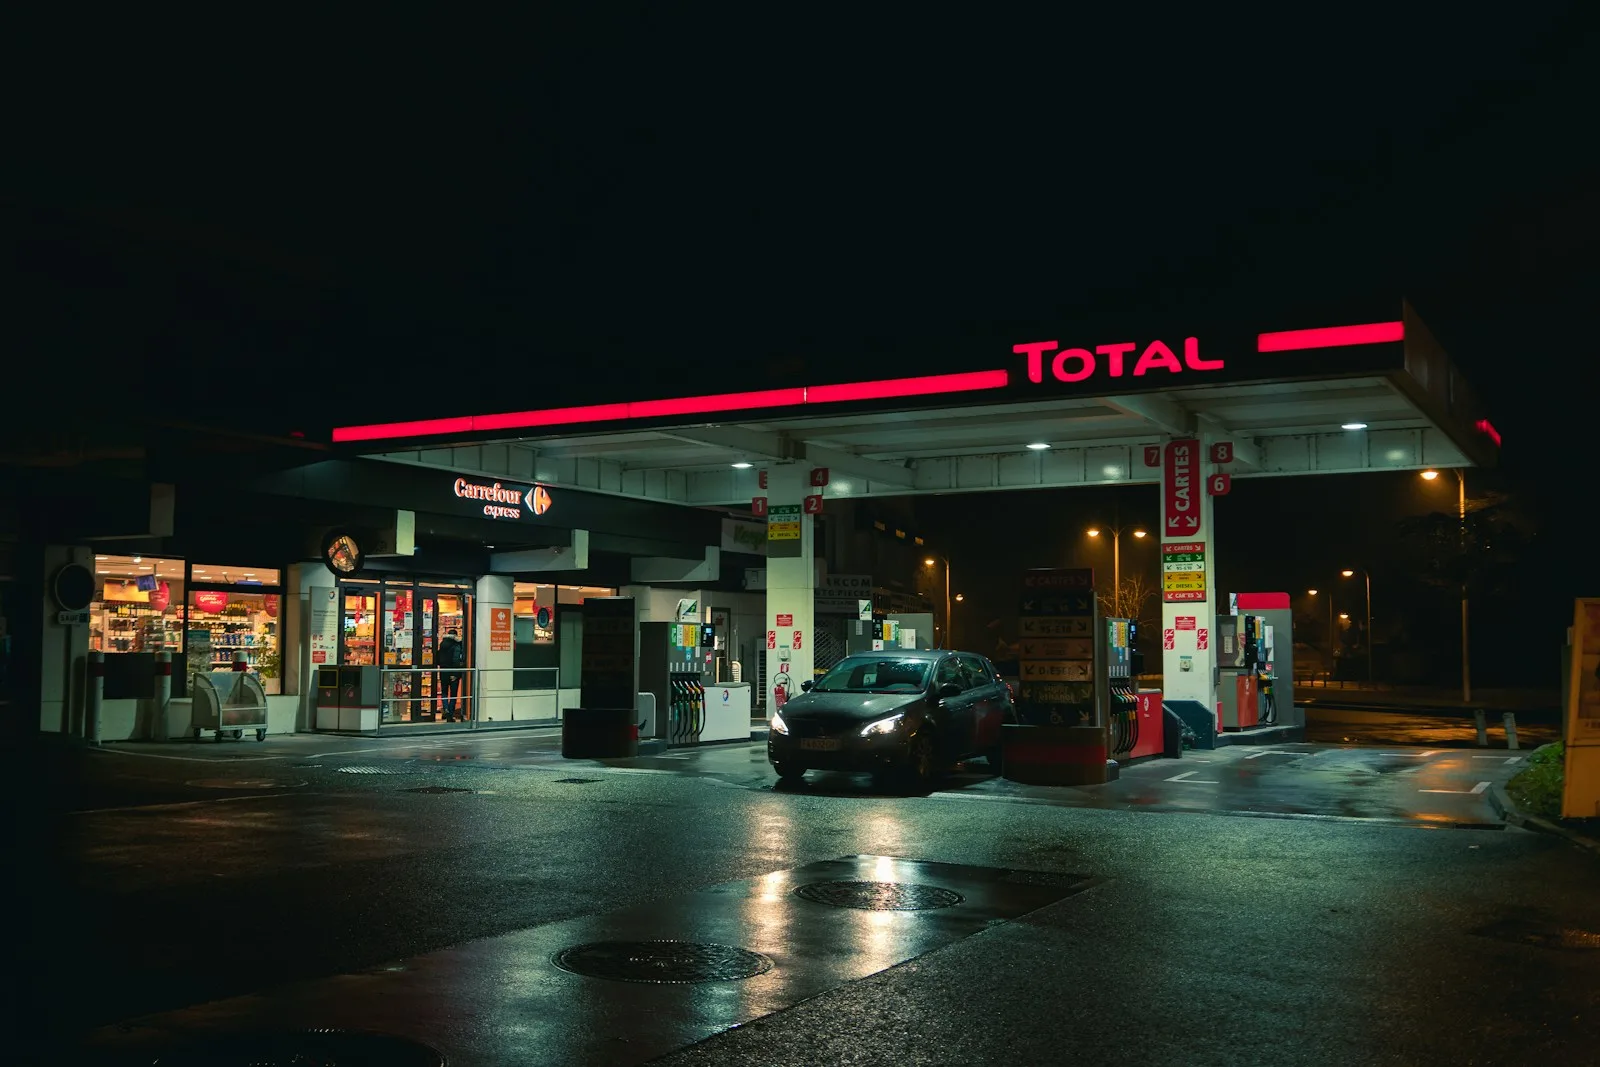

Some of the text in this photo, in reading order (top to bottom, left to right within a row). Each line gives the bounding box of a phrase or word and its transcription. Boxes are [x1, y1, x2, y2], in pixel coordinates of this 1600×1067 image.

[1013, 337, 1225, 384] TOTAL
[1149, 449, 1159, 464] 7
[1217, 445, 1228, 460] 8
[815, 471, 824, 485] 4
[1174, 445, 1191, 512] CARTES
[1213, 476, 1225, 492] 6
[454, 477, 522, 505] Carrefour
[484, 504, 520, 519] express
[756, 499, 763, 513] 1
[809, 497, 818, 511] 2
[1037, 576, 1075, 586] CARTES
[1039, 625, 1072, 634] 95-E10
[1038, 667, 1073, 676] DIESEL
